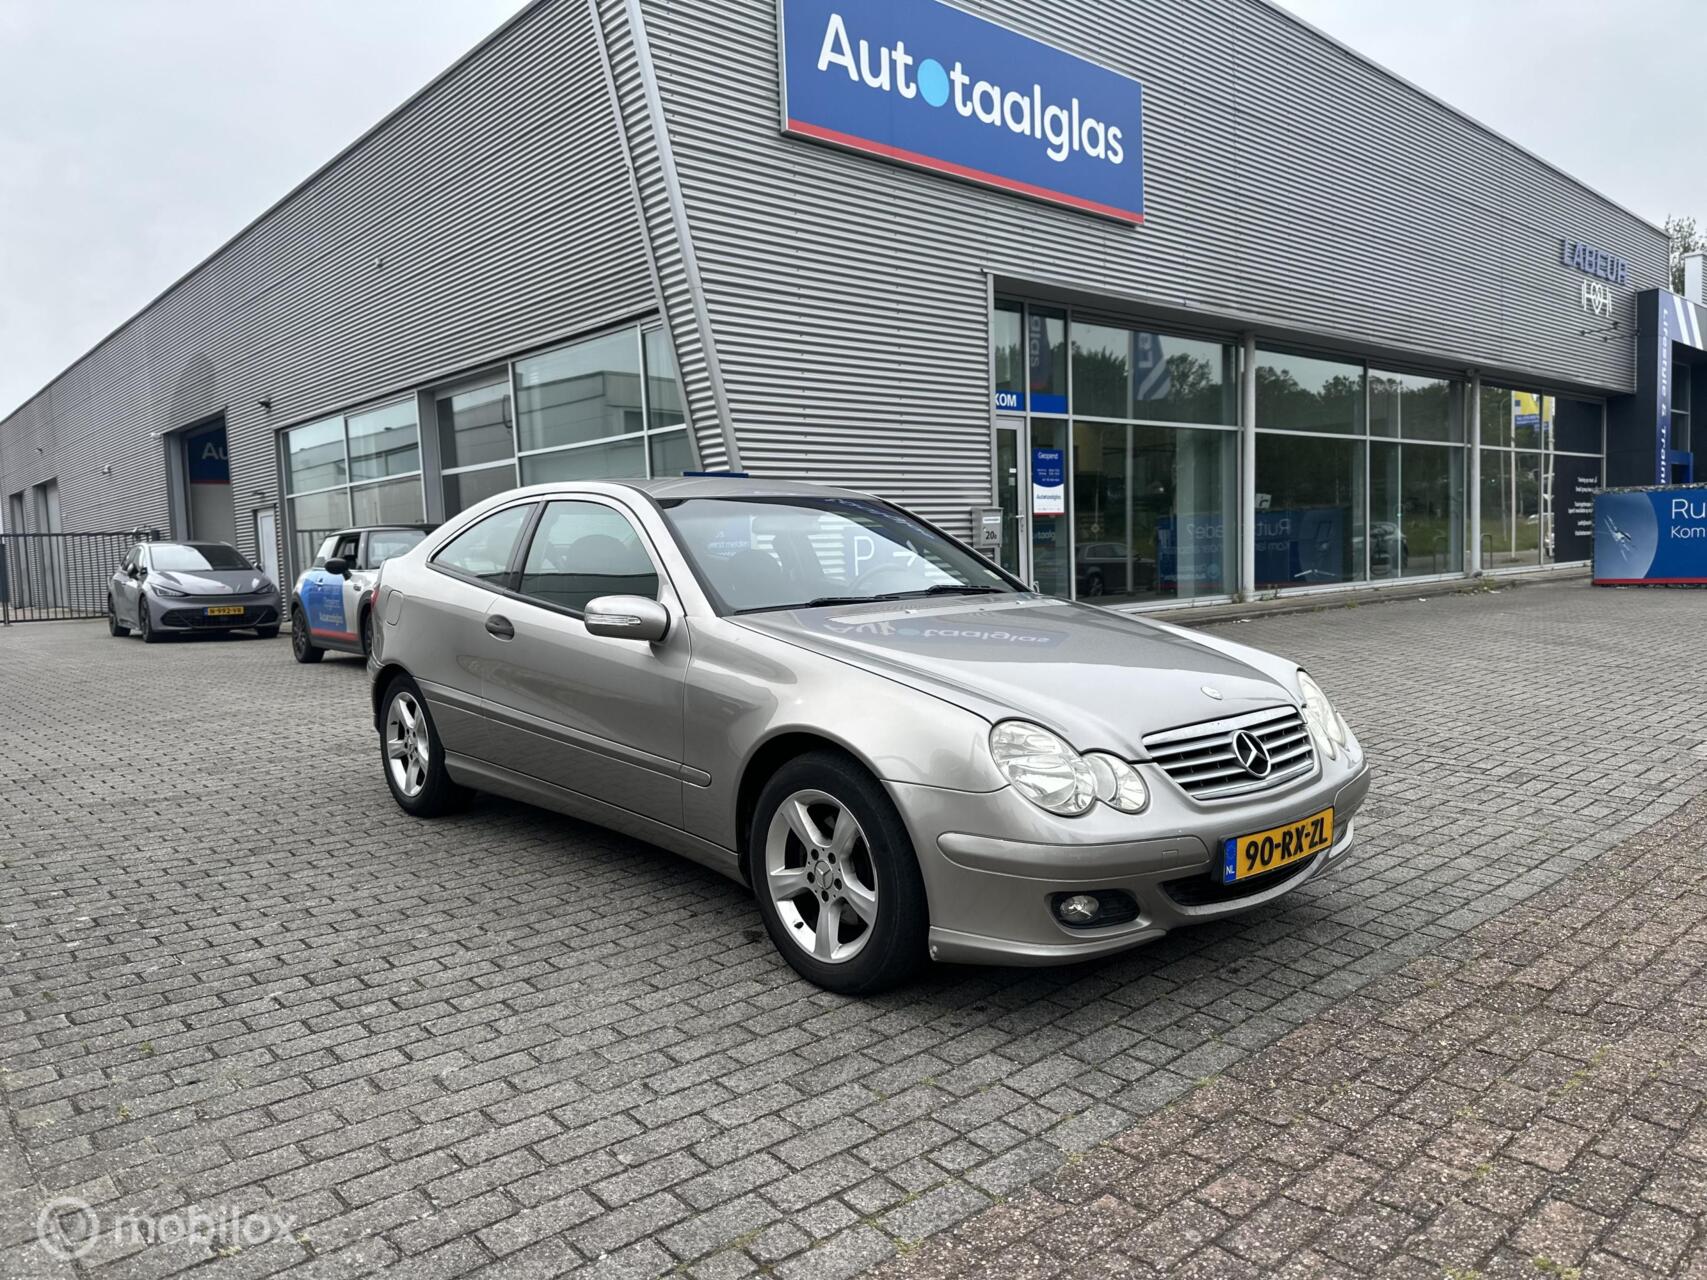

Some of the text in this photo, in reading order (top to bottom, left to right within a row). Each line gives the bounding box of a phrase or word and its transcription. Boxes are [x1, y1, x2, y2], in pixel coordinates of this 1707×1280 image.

[817, 13, 1124, 164] Autotaalglas
[1671, 525, 1706, 538] Kom
[1245, 817, 1328, 872] 90-RX-ZL
[1225, 864, 1235, 875] NL
